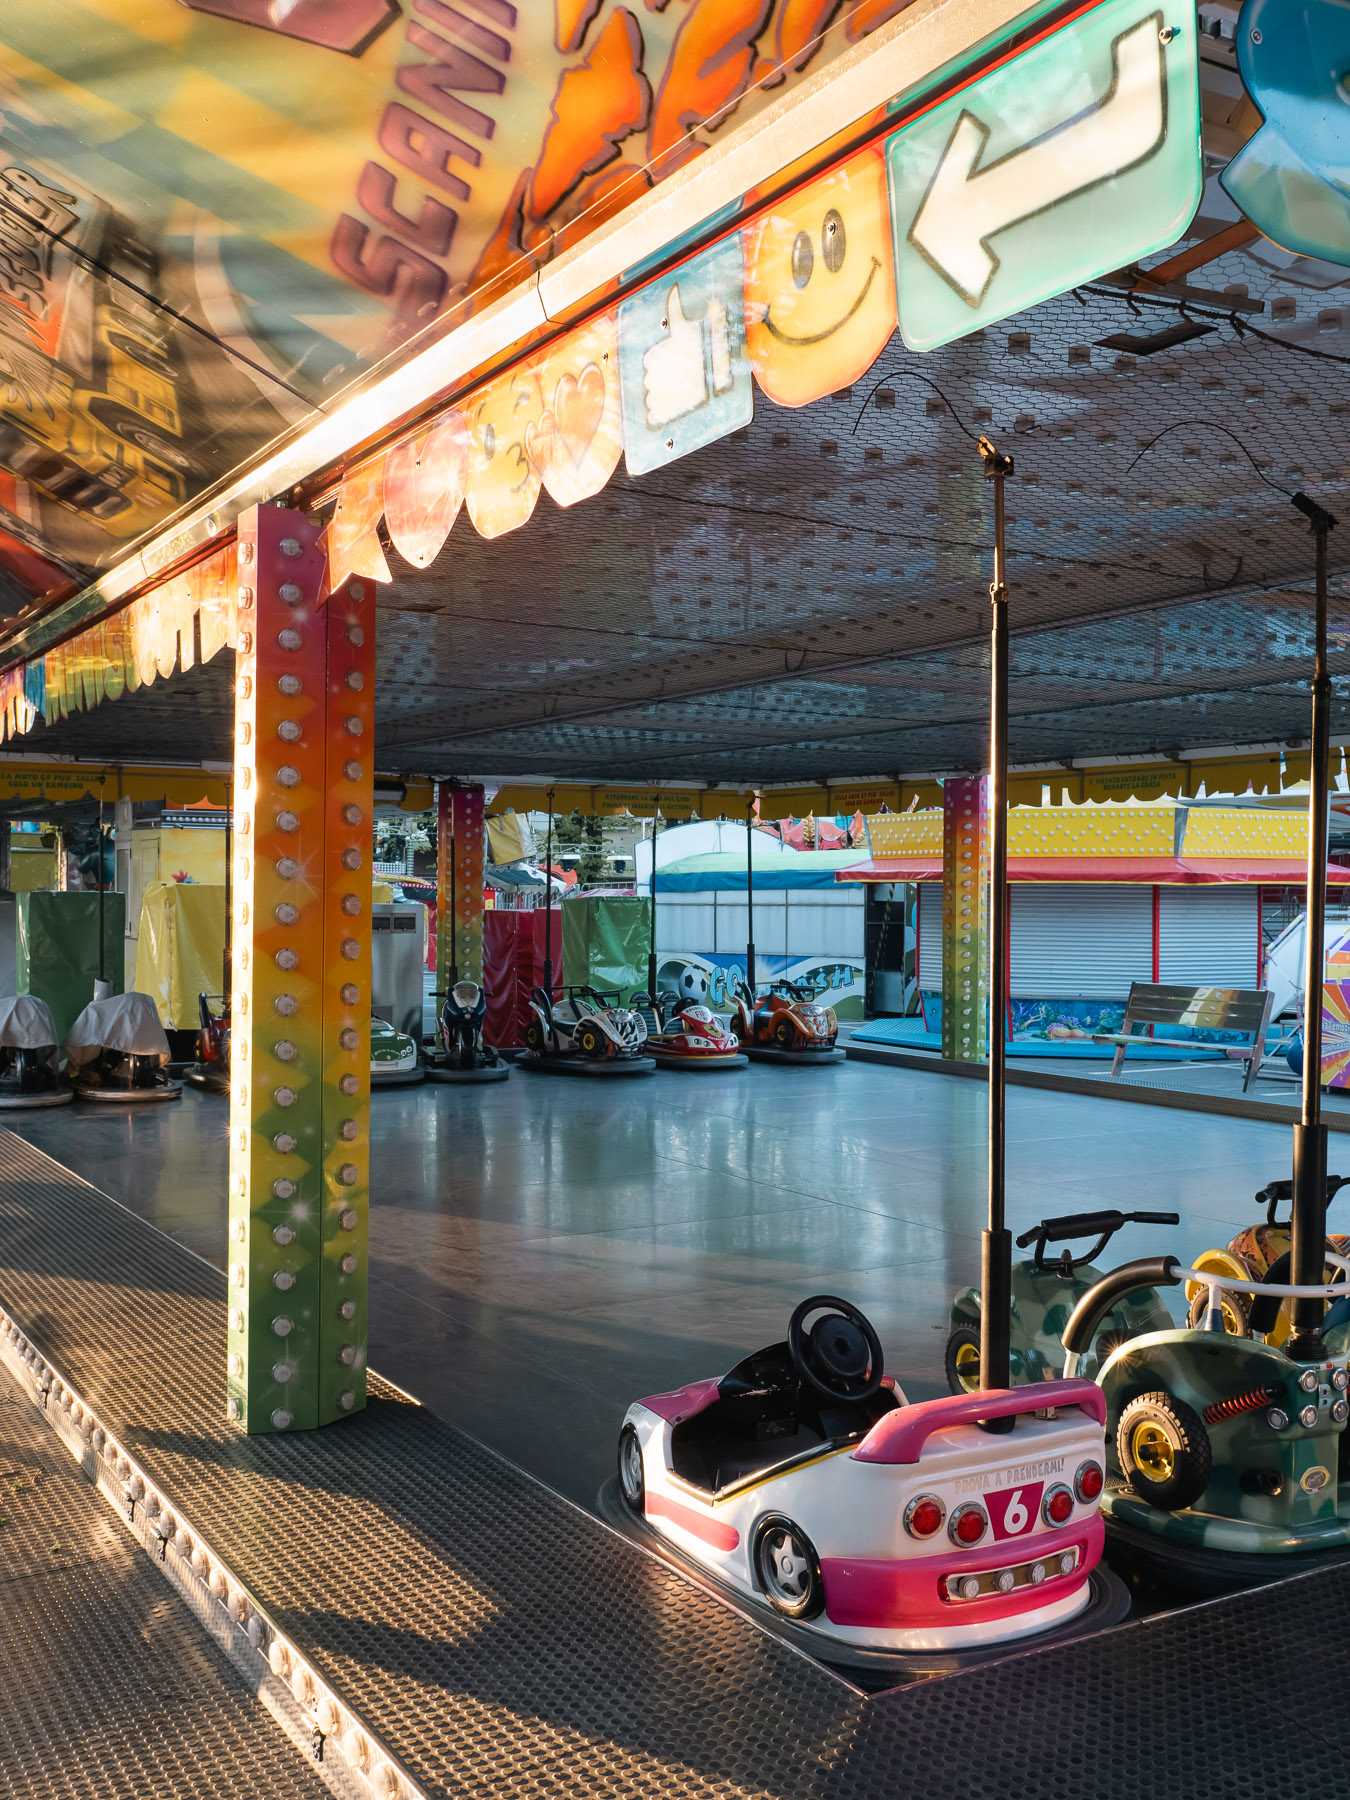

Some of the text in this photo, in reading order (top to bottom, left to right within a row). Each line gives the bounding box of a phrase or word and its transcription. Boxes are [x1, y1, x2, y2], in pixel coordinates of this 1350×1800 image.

[954, 1458, 1065, 1496] PROVA A PRENDERMI!
[1003, 1489, 1029, 1535] 6
